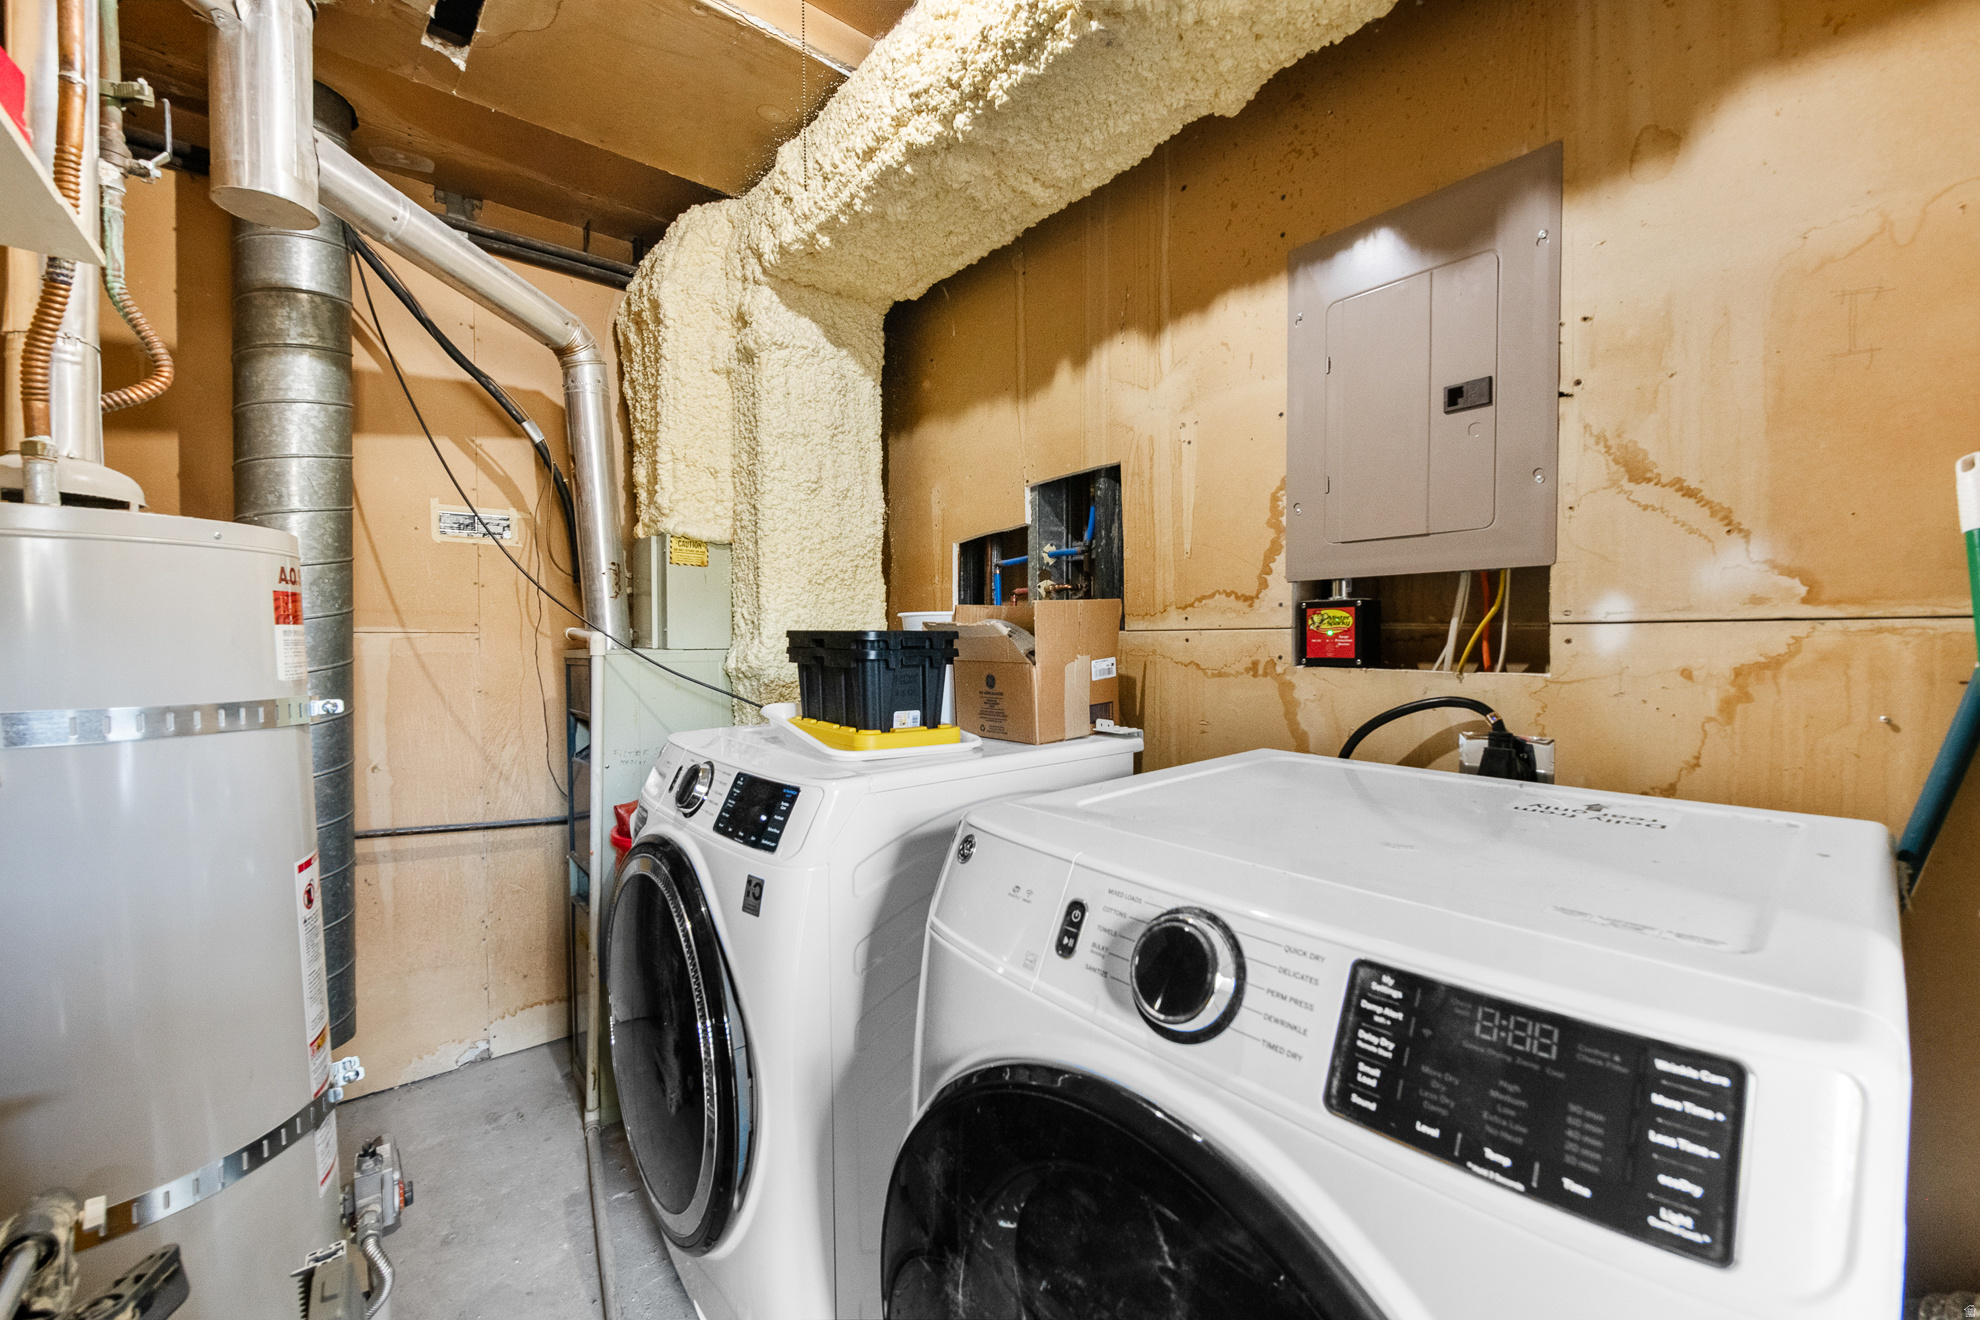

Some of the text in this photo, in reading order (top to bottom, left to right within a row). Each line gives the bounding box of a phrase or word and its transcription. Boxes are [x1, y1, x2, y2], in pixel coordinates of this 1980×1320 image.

[1513, 806, 1667, 829] Dolly from
[1528, 803, 1658, 823] rear only
[1108, 888, 1143, 904] MIXED LOADS
[1102, 905, 1127, 919] COTTONS
[1097, 924, 1118, 938] TOWELS
[1284, 944, 1326, 963] QUICK DRY
[1277, 966, 1320, 986] DELICATES
[1266, 987, 1315, 1012] PERM PRESS
[1262, 1012, 1309, 1037] DEWRINKLE
[1261, 1038, 1303, 1062] TIMED DRY
